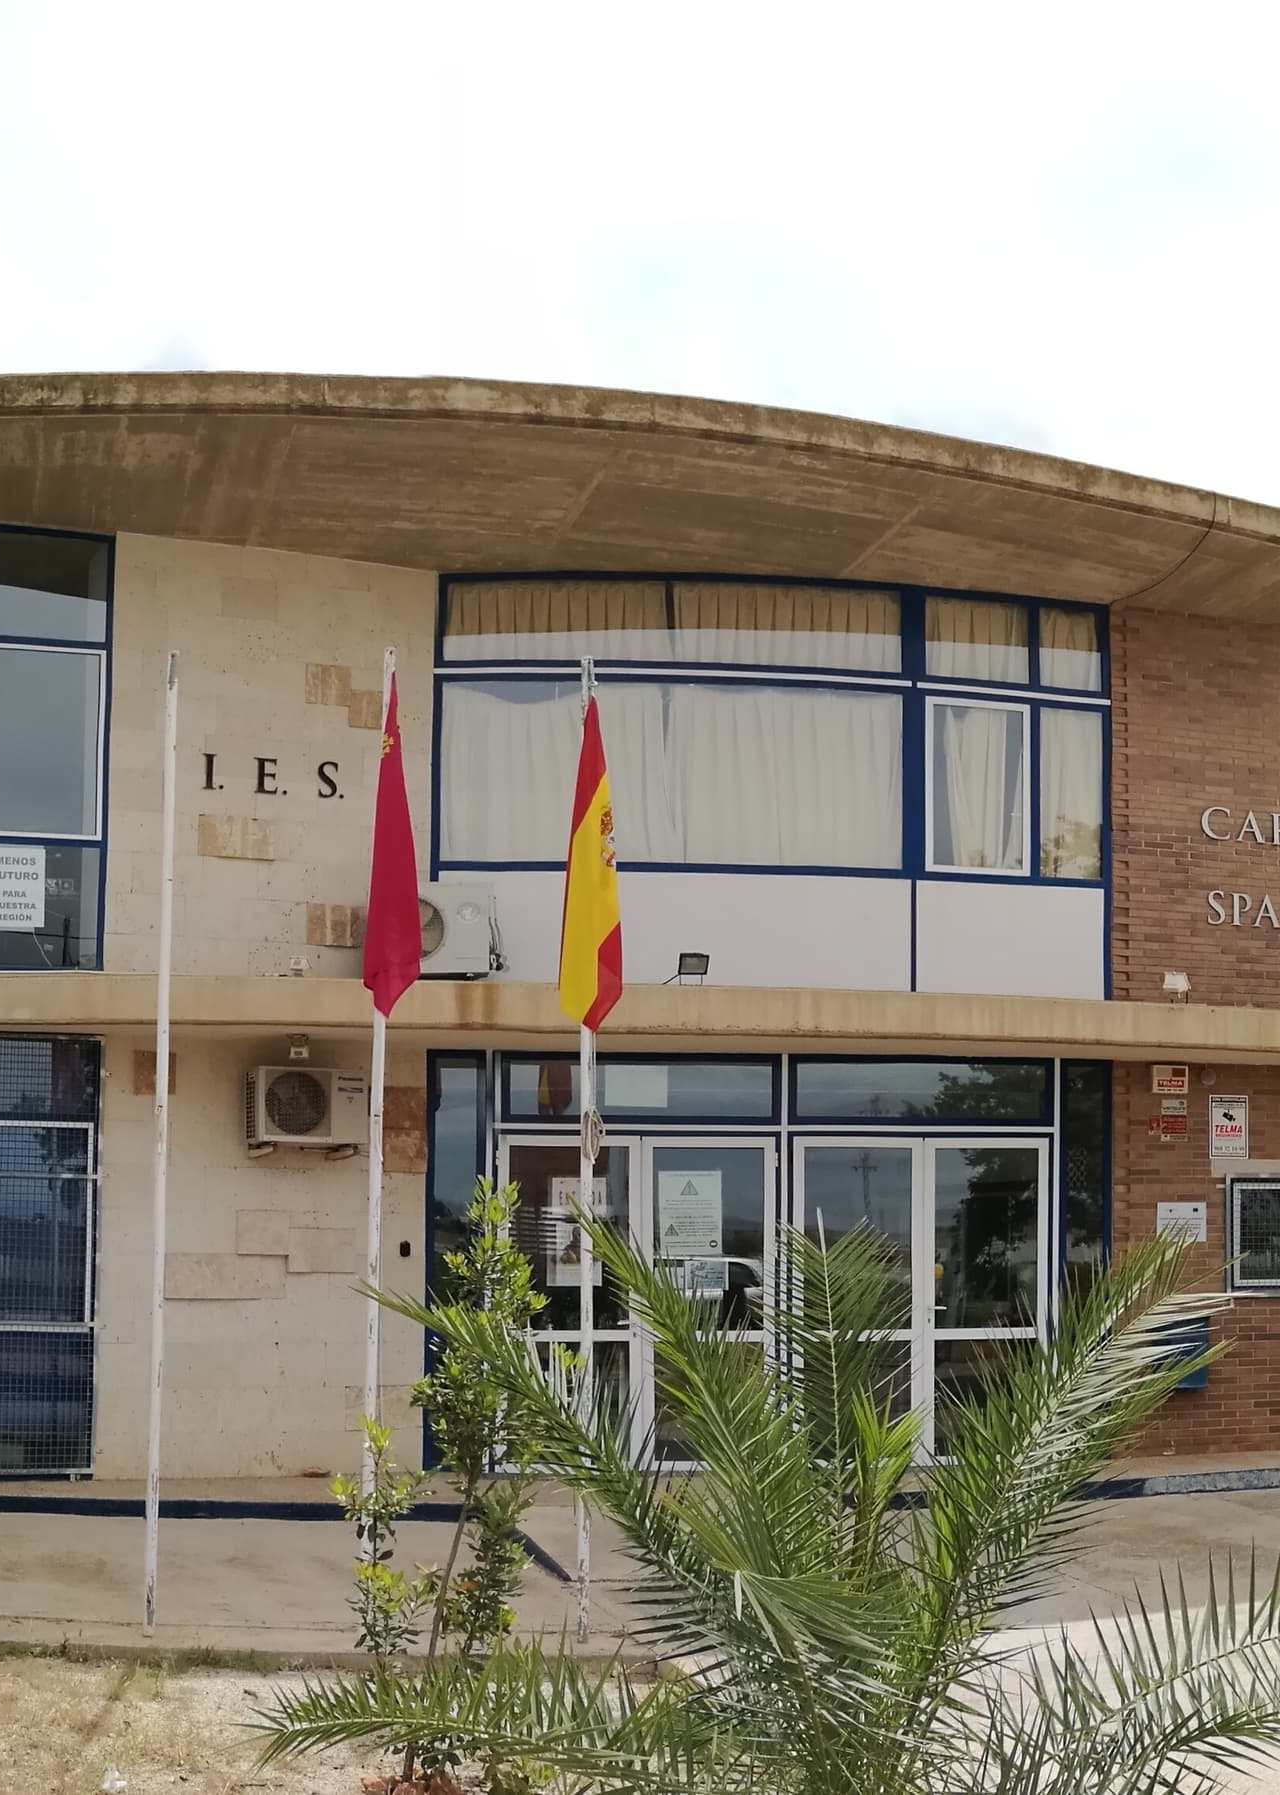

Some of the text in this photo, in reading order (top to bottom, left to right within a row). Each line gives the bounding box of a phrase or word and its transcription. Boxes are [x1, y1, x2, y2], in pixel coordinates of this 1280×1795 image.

[202, 753, 344, 799] I. E. S.
[2, 890, 27, 898] PARA
[1215, 1124, 1242, 1133] TELMA
